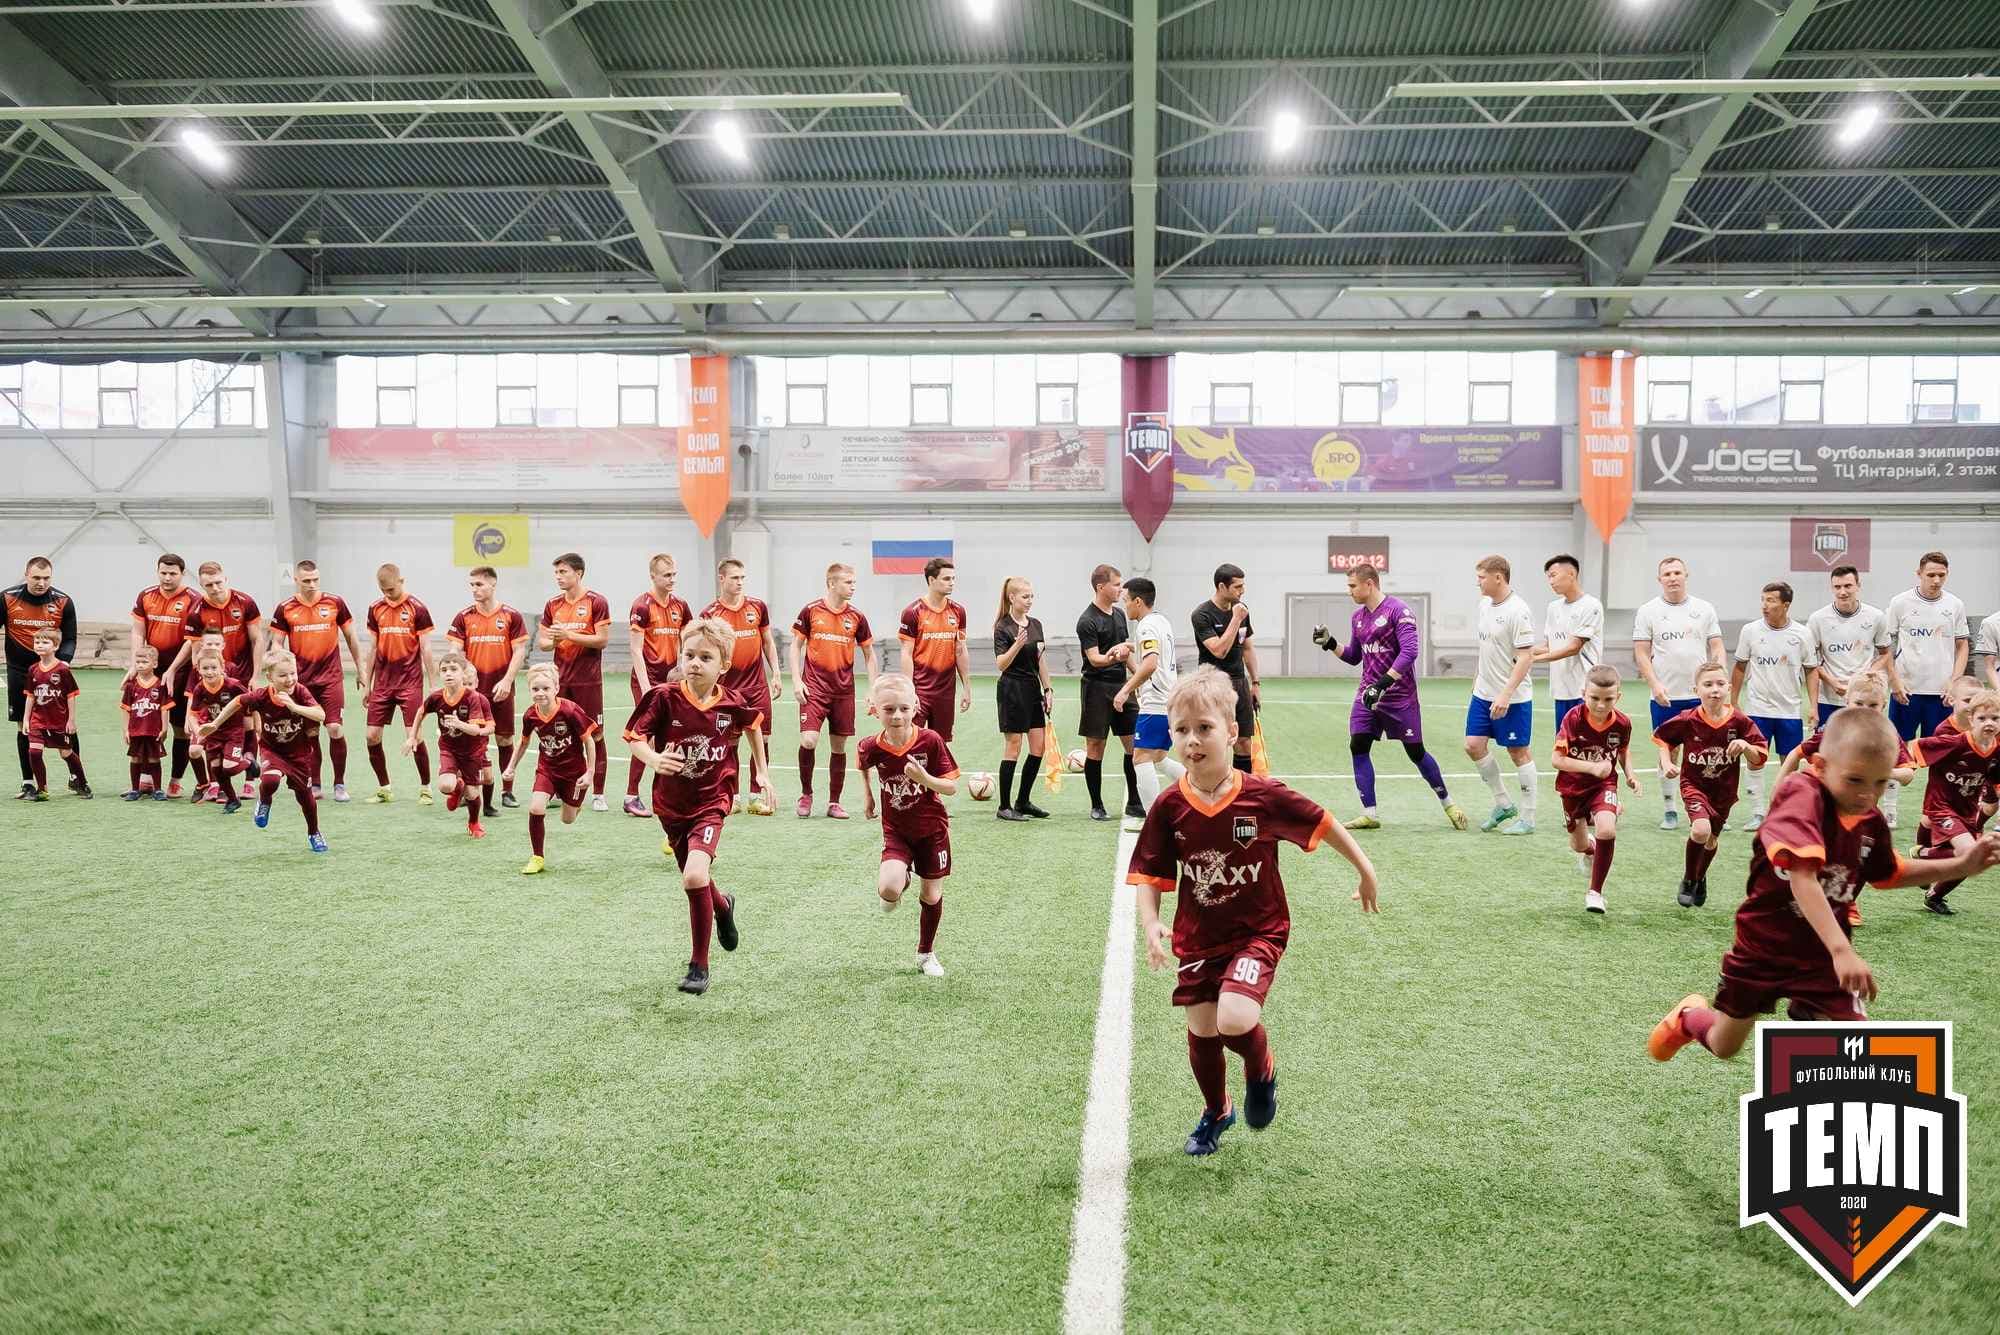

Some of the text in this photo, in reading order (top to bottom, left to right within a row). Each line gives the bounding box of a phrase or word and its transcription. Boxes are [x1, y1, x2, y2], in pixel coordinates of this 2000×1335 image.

[687, 432, 719, 453] ОДНА
[1130, 429, 1168, 451] ТЕМП
[1584, 434, 1629, 453] ТОЛЬКО
[1817, 446, 1914, 462] Футбольная
[684, 456, 725, 474] СЕМЬЯ!
[1834, 464, 1855, 480] ТЦ
[1945, 463, 1954, 476] 2
[1958, 464, 1998, 477] этаж
[1661, 631, 1686, 641] GNV
[1909, 627, 1934, 637] GNV
[1828, 643, 1853, 653] GNV
[1757, 656, 1779, 665] GNV
[1233, 957, 1261, 985] 96
